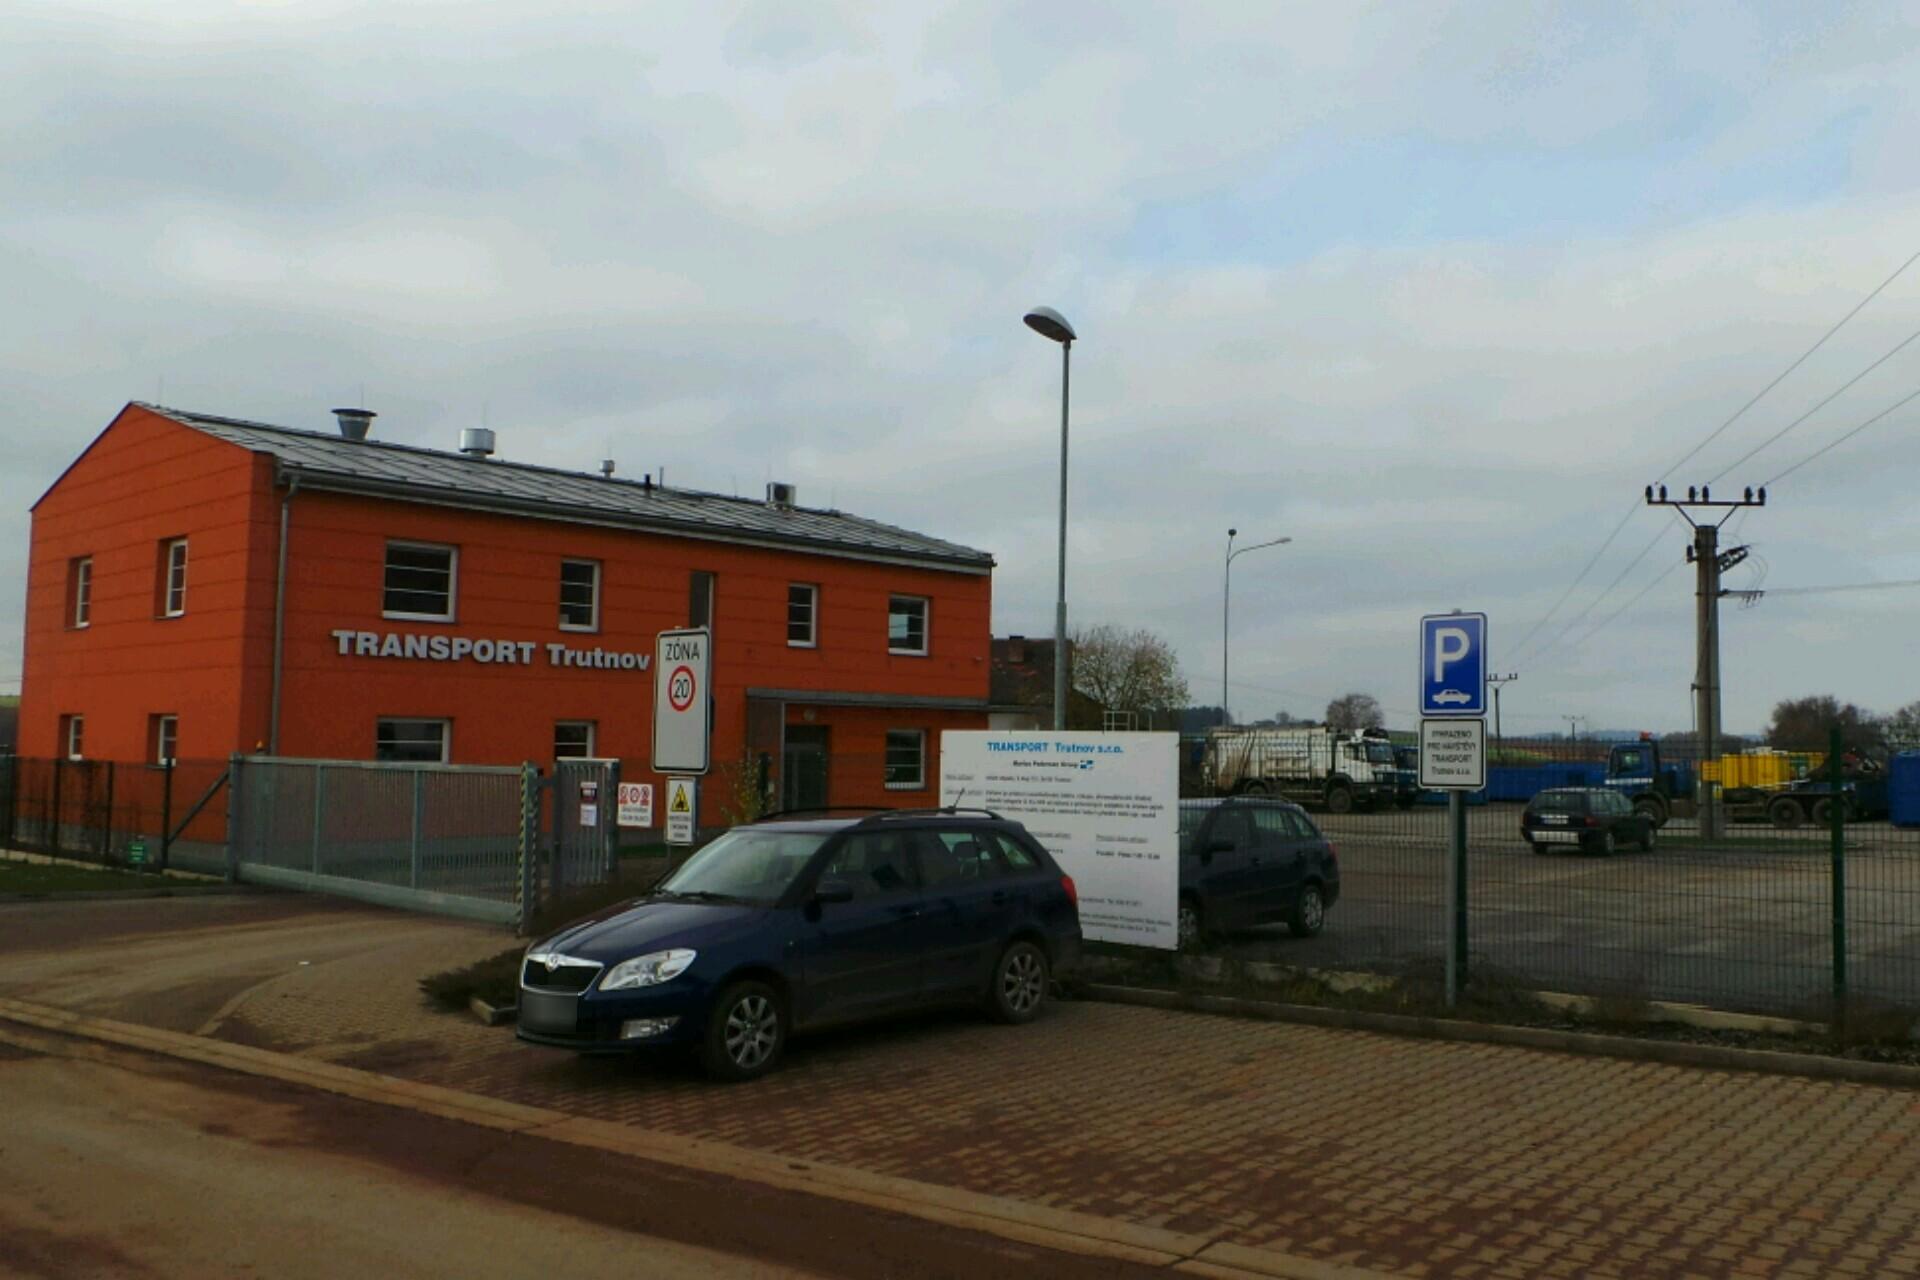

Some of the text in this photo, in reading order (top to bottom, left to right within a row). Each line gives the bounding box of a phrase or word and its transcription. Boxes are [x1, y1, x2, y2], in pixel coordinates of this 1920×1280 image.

[331, 629, 650, 671] TRANSPORT Trutnov
[665, 637, 700, 661] ZÓNA
[1434, 627, 1471, 683] P
[674, 678, 690, 698] 20
[987, 742, 1048, 752] TRANSPORT
[1055, 742, 1095, 753] Trutnov
